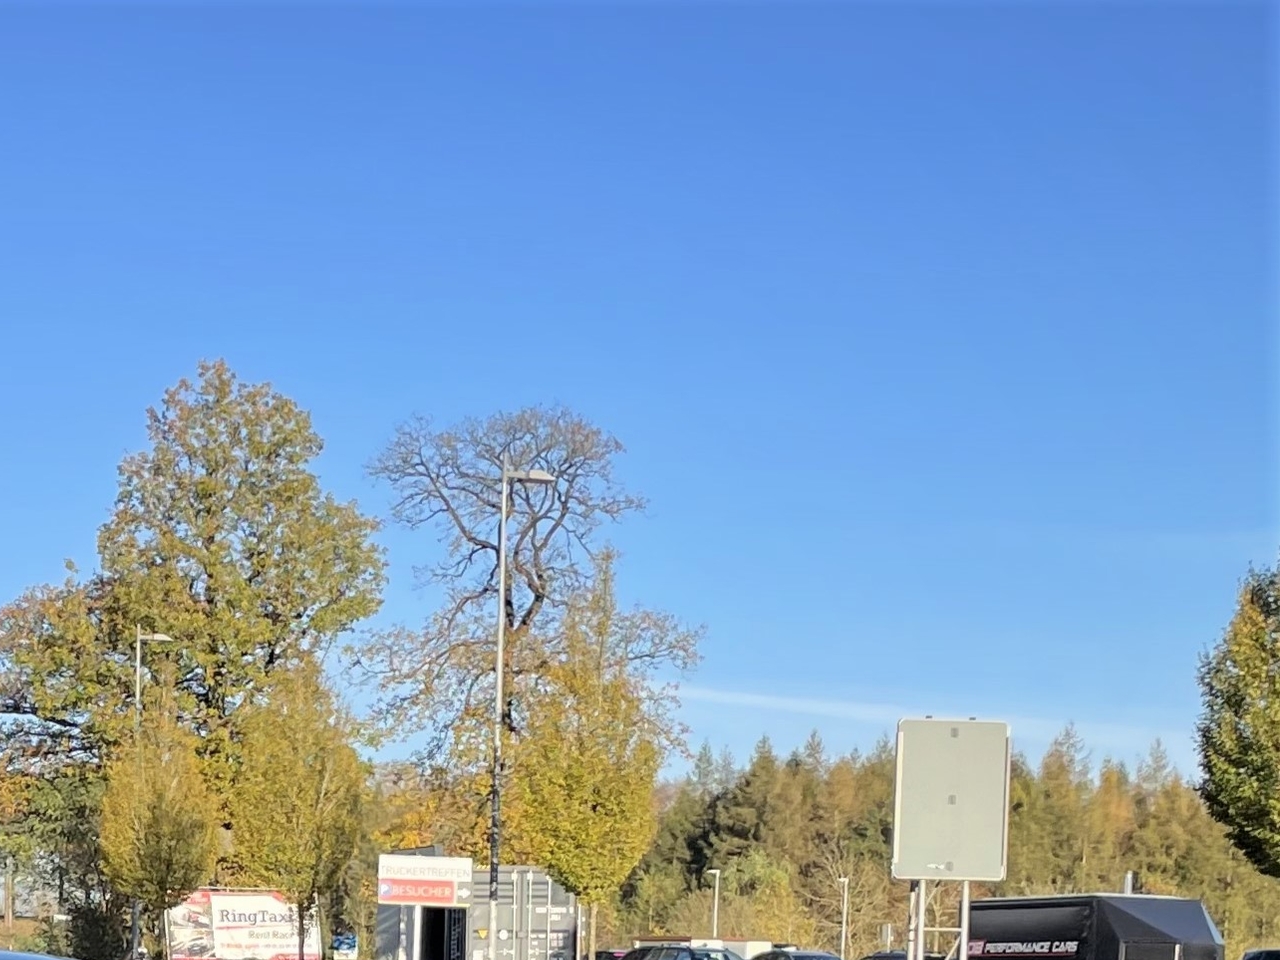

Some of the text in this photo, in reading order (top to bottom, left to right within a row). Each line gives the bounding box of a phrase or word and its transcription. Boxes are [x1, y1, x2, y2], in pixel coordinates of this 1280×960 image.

[381, 865, 470, 878] TRUCKERTREFFEN
[392, 885, 452, 897] BESUCHER
[985, 942, 1051, 953] PERFORMANCE
[1052, 941, 1079, 952] CARS
